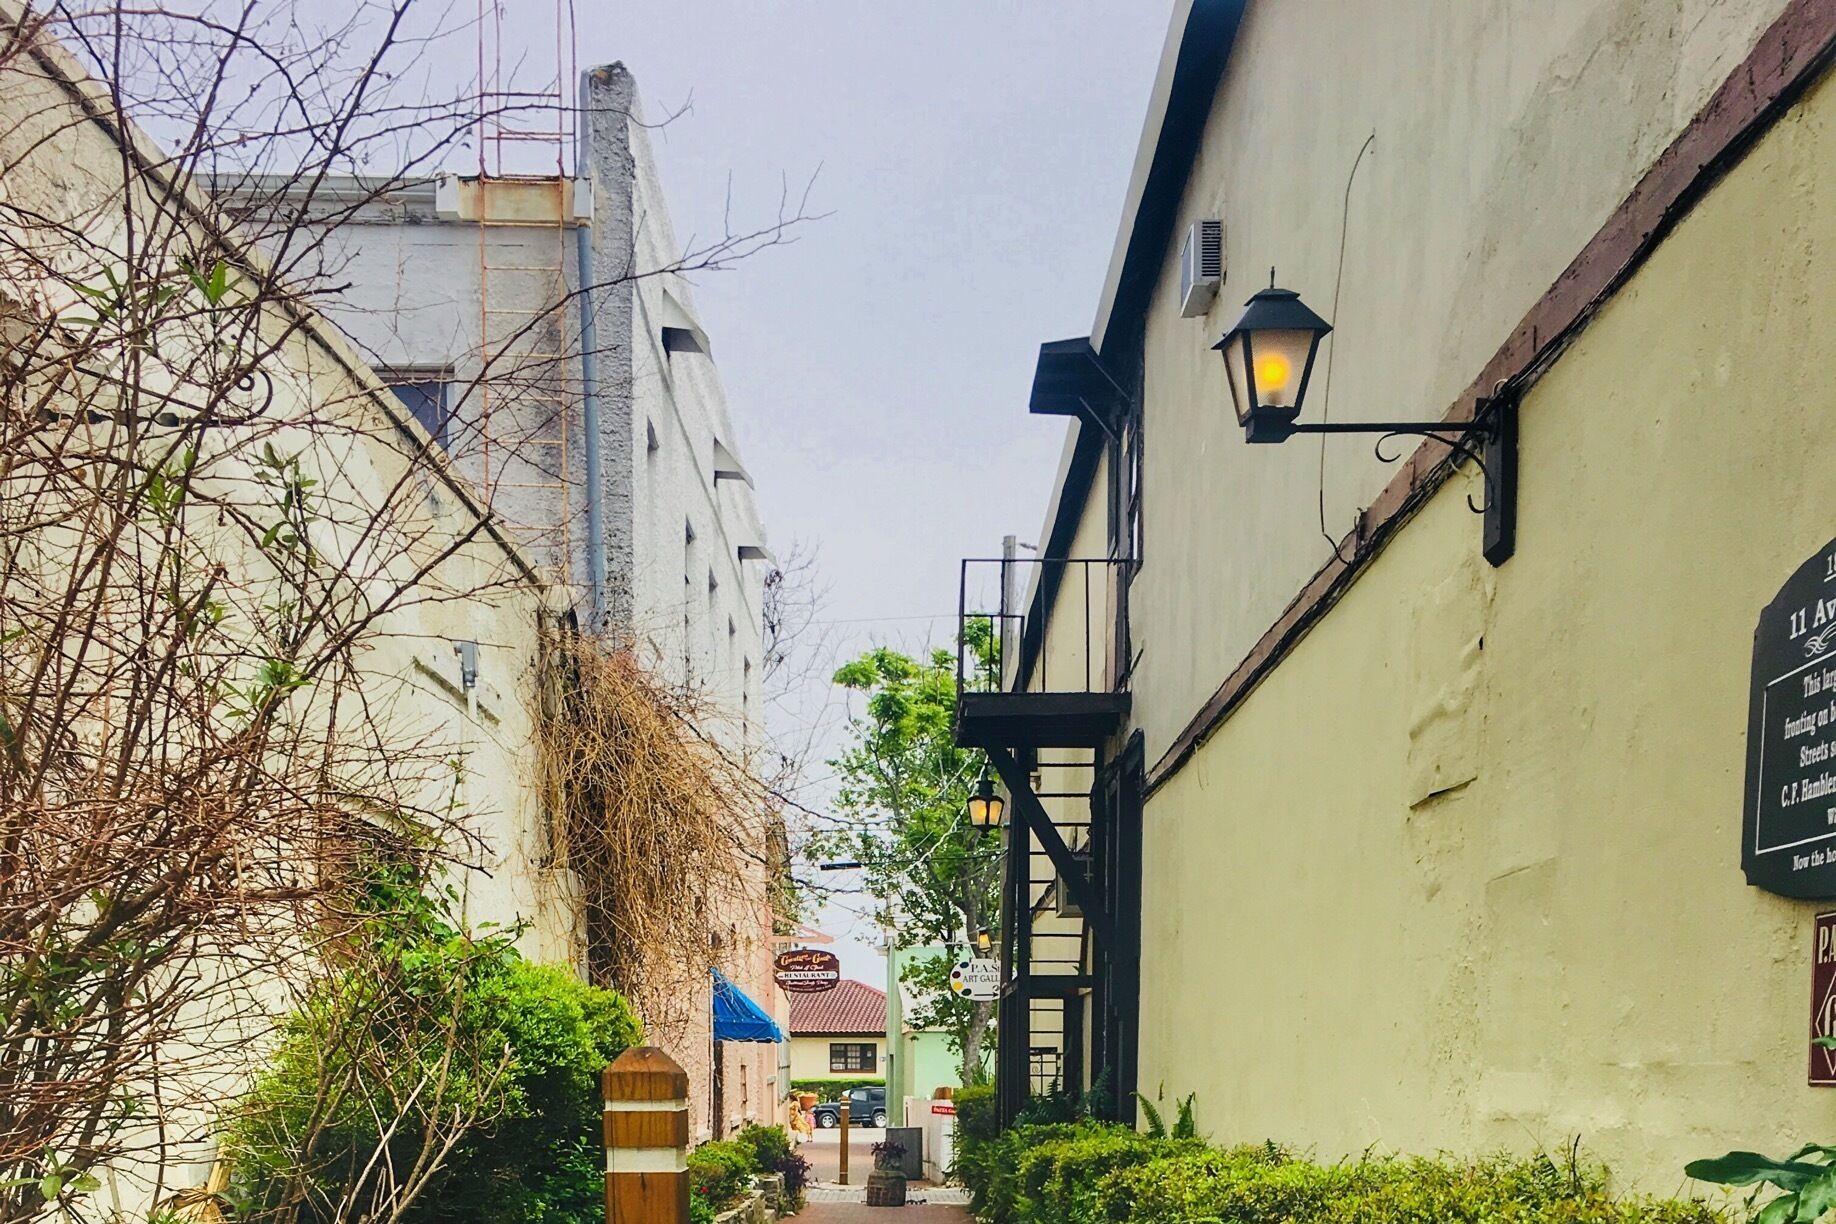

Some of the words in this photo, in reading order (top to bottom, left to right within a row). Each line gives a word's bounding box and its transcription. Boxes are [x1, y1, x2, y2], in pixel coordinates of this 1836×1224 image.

[1827, 552, 1836, 575] 1
[1789, 607, 1807, 640] 11
[1803, 672, 1821, 698] This
[1784, 710, 1817, 740] fronting
[1817, 708, 1829, 727] on
[1800, 740, 1829, 767] Streets
[1793, 854, 1810, 871] Now
[1811, 850, 1825, 867] the
[963, 974, 979, 983] ART
